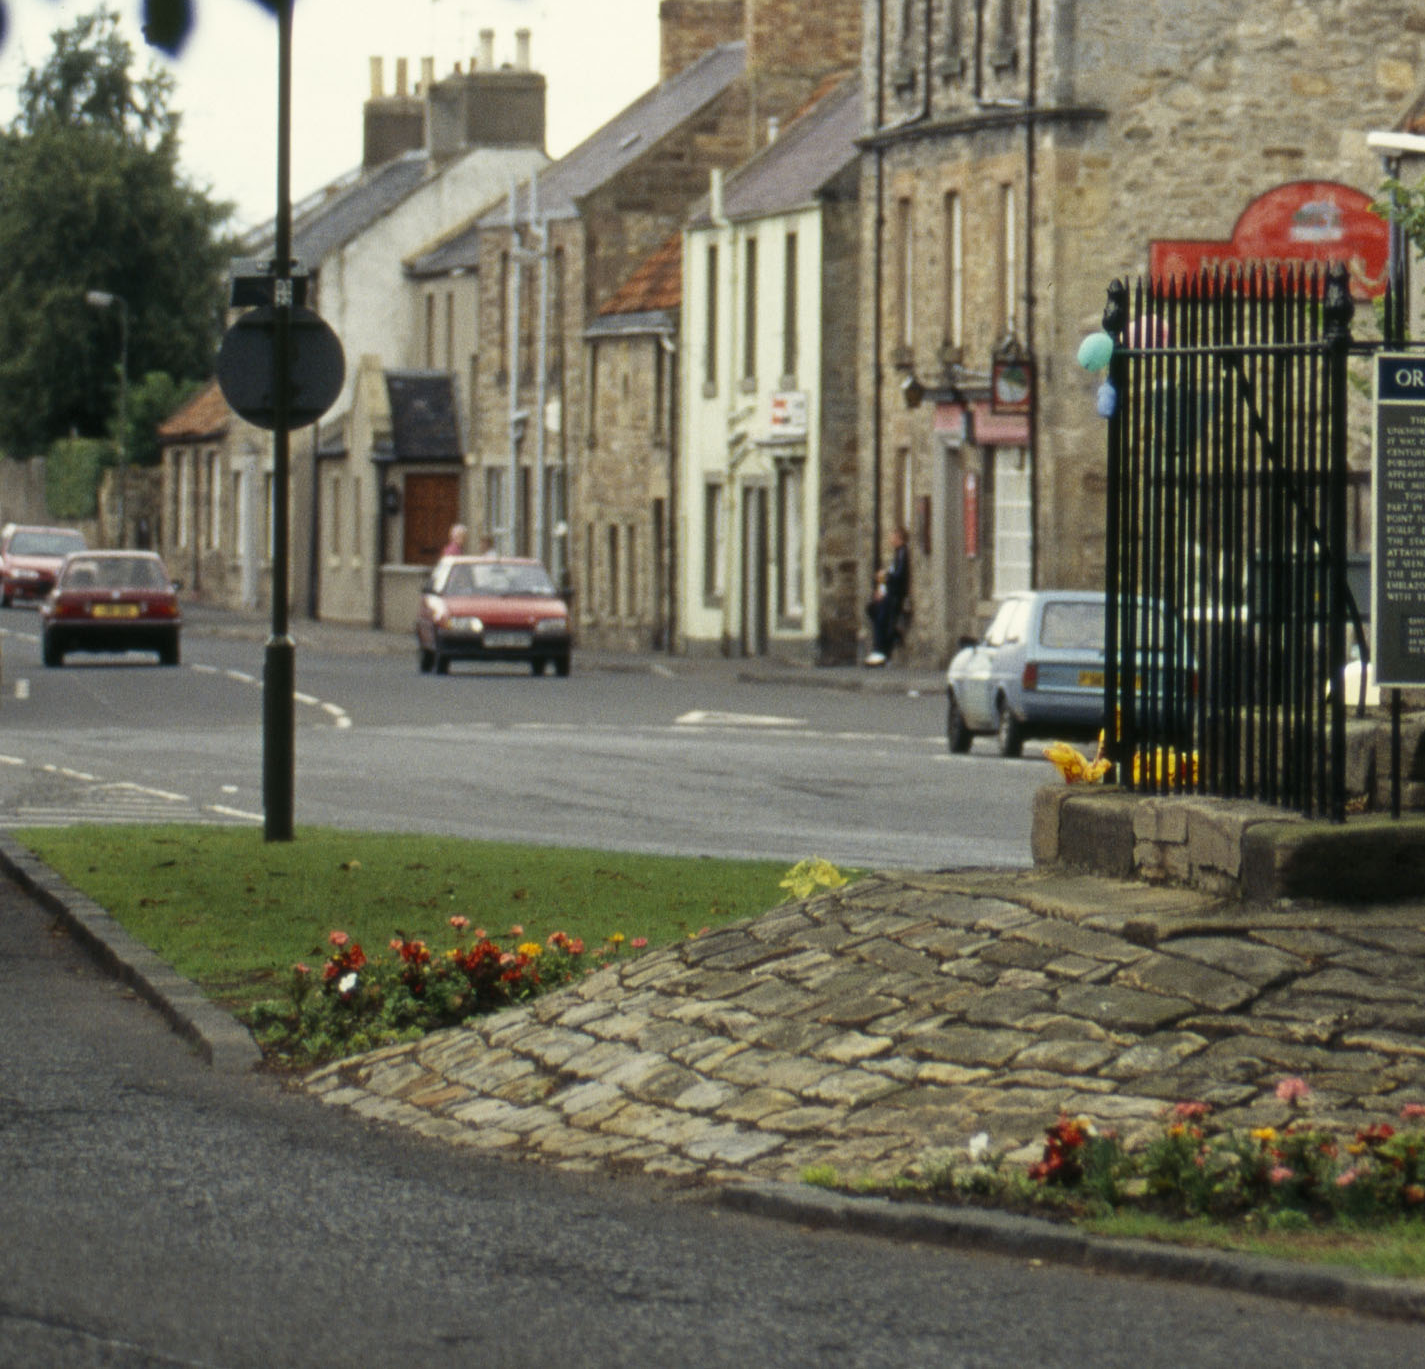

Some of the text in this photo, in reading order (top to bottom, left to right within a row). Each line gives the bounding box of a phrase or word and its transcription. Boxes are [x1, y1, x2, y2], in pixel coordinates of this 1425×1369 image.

[1387, 449, 1425, 458] CENTURY
[1388, 482, 1405, 491] THE
[1387, 504, 1408, 513] PART
[1387, 538, 1404, 547] THE
[1388, 571, 1404, 580] THE
[1387, 593, 1411, 602] WITH
